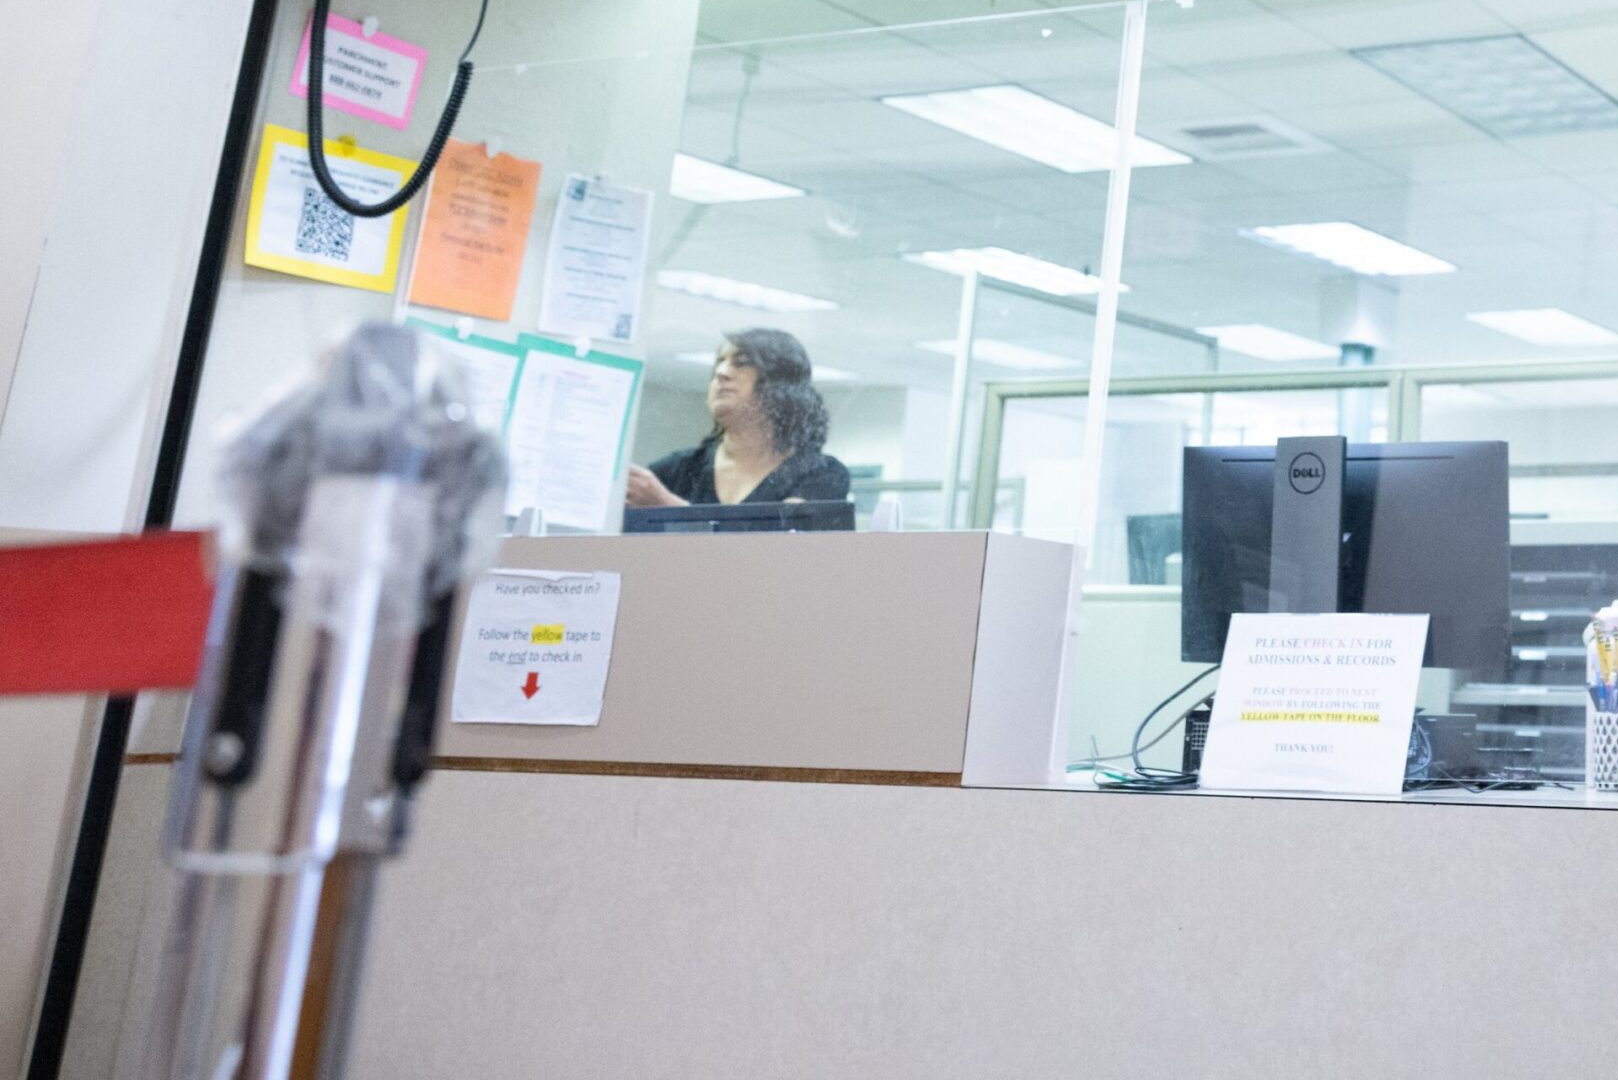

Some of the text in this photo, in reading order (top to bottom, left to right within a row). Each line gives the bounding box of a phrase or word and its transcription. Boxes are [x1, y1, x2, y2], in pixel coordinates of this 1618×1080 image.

[1292, 467, 1321, 479] DELL
[495, 583, 600, 597] Have you checked in?
[478, 628, 601, 643] Follow the yellow tape to
[1255, 637, 1393, 650] PLEASE CHECK IN FOR
[488, 650, 583, 665] the end to check in
[1247, 654, 1397, 667] ADMISSIONS & RECORDS
[1252, 686, 1286, 696] PLEASE
[1300, 700, 1359, 710] FOLLOWING
[1274, 743, 1308, 753] THANK
